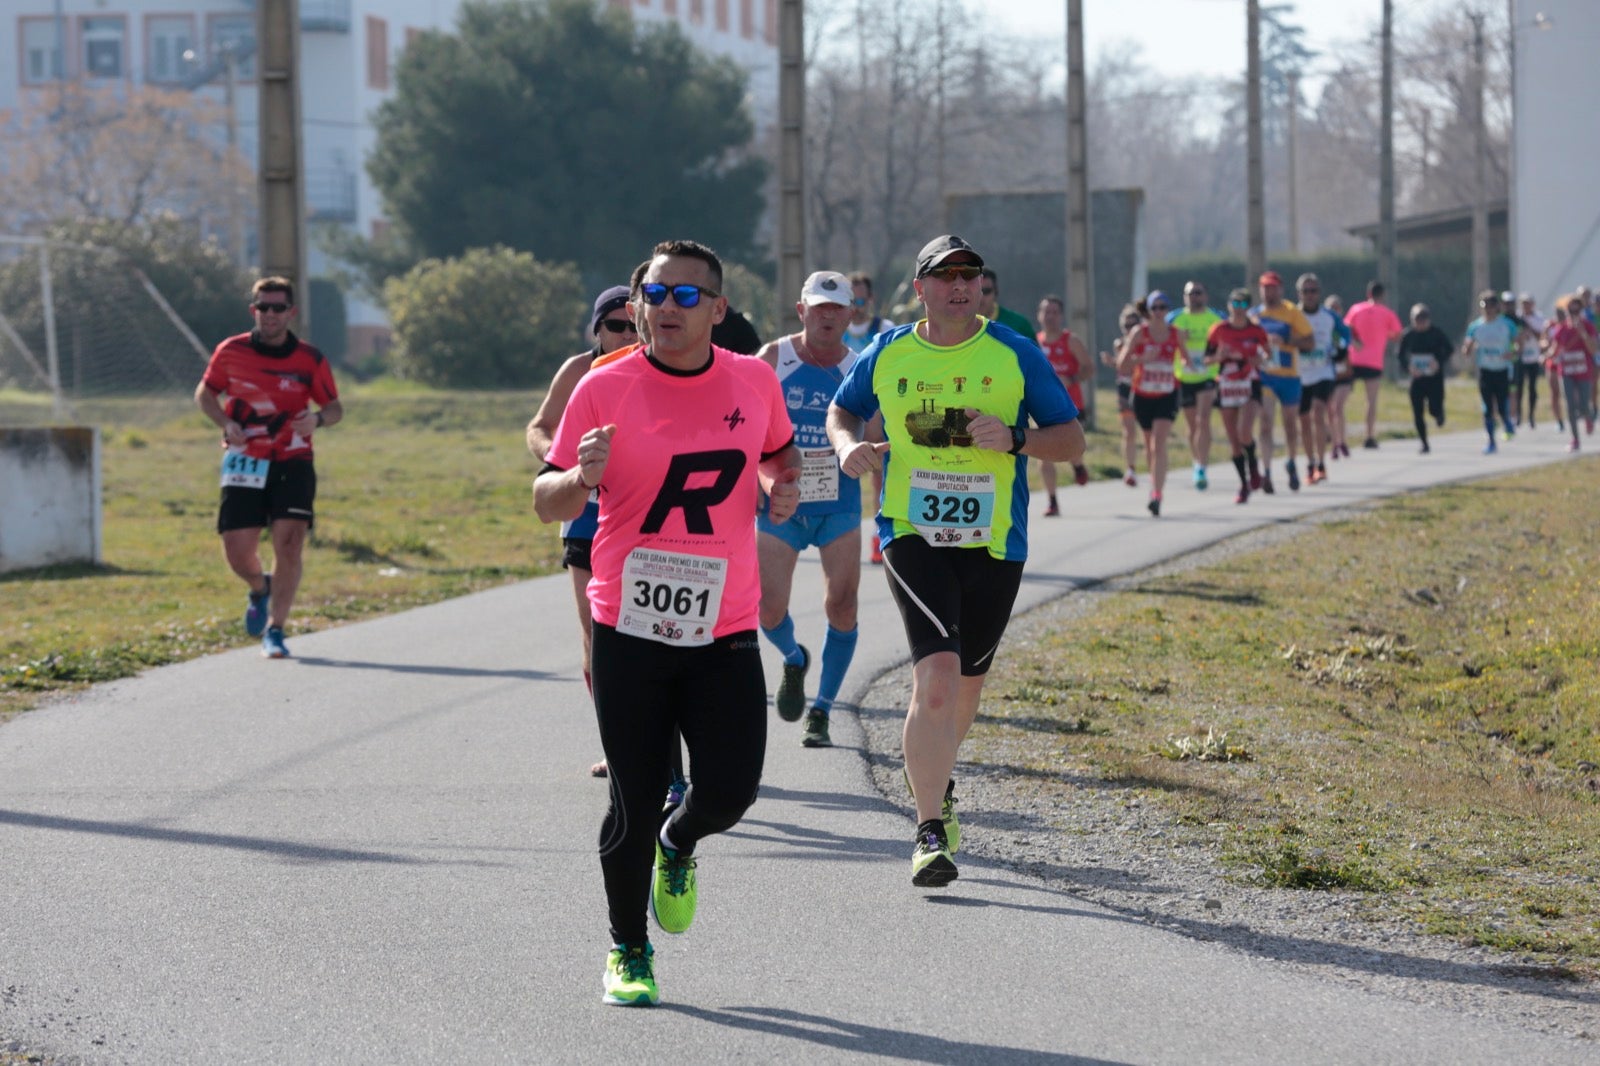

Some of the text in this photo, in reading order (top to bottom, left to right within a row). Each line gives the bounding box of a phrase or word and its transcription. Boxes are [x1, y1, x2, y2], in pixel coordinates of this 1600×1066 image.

[228, 455, 259, 472] 411
[931, 472, 945, 481] GRAN
[946, 473, 966, 483] PREMIO
[966, 475, 973, 483] DE
[973, 474, 990, 483] FONDO
[639, 448, 747, 535] R
[937, 482, 969, 491] DIPUTACIÓN
[922, 494, 980, 524] 329
[643, 562, 675, 573] DIPUTACIÓN
[684, 567, 708, 577] GRANADA
[650, 553, 667, 563] GRAN
[668, 556, 691, 567] PREMIO
[692, 559, 700, 568] DE
[701, 560, 721, 571] FONDO
[633, 580, 710, 618] 3061
